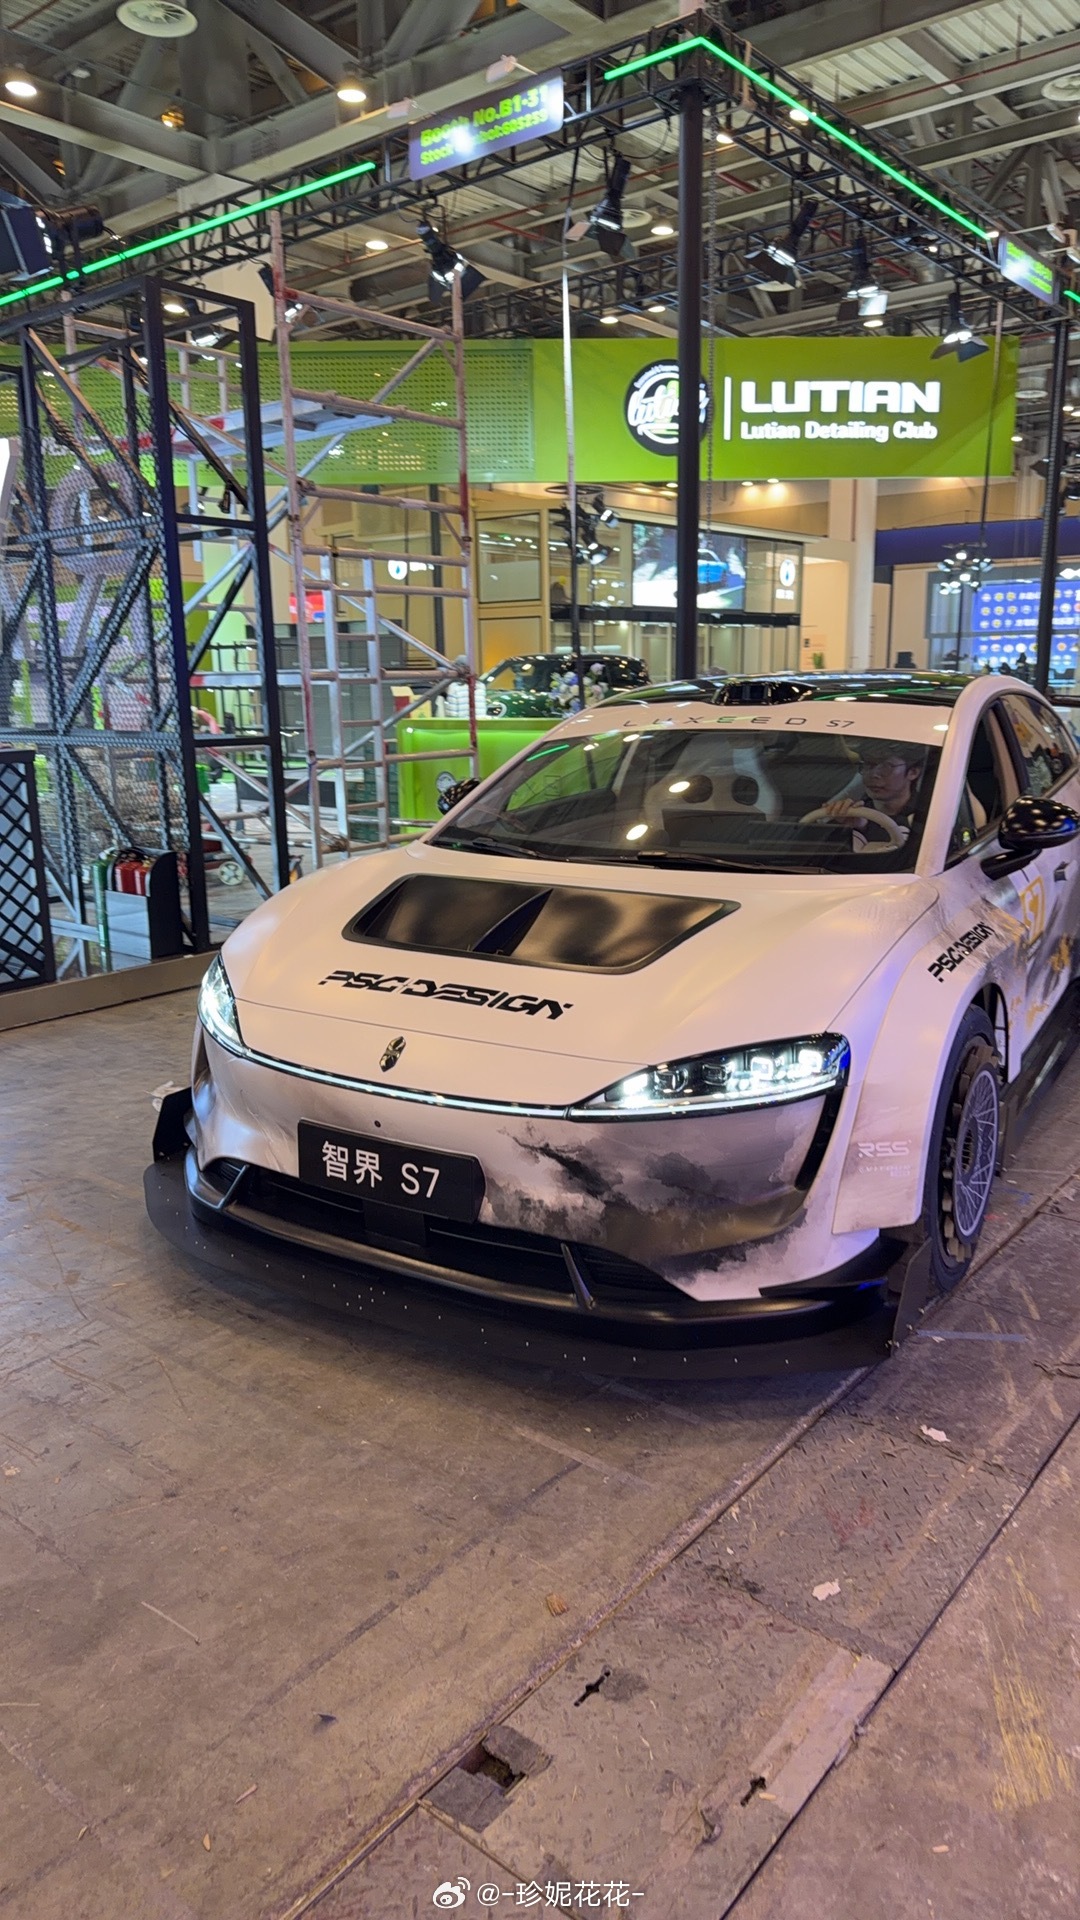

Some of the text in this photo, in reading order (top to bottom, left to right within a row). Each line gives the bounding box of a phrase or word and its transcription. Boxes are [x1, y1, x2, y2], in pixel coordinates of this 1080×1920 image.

[741, 381, 940, 413] LUTIAN
[741, 421, 938, 443] Lutian Detailing Club
[623, 716, 855, 729] LUXEED S7
[857, 1140, 912, 1158] RSS
[321, 1140, 440, 1199] 智界 S7
